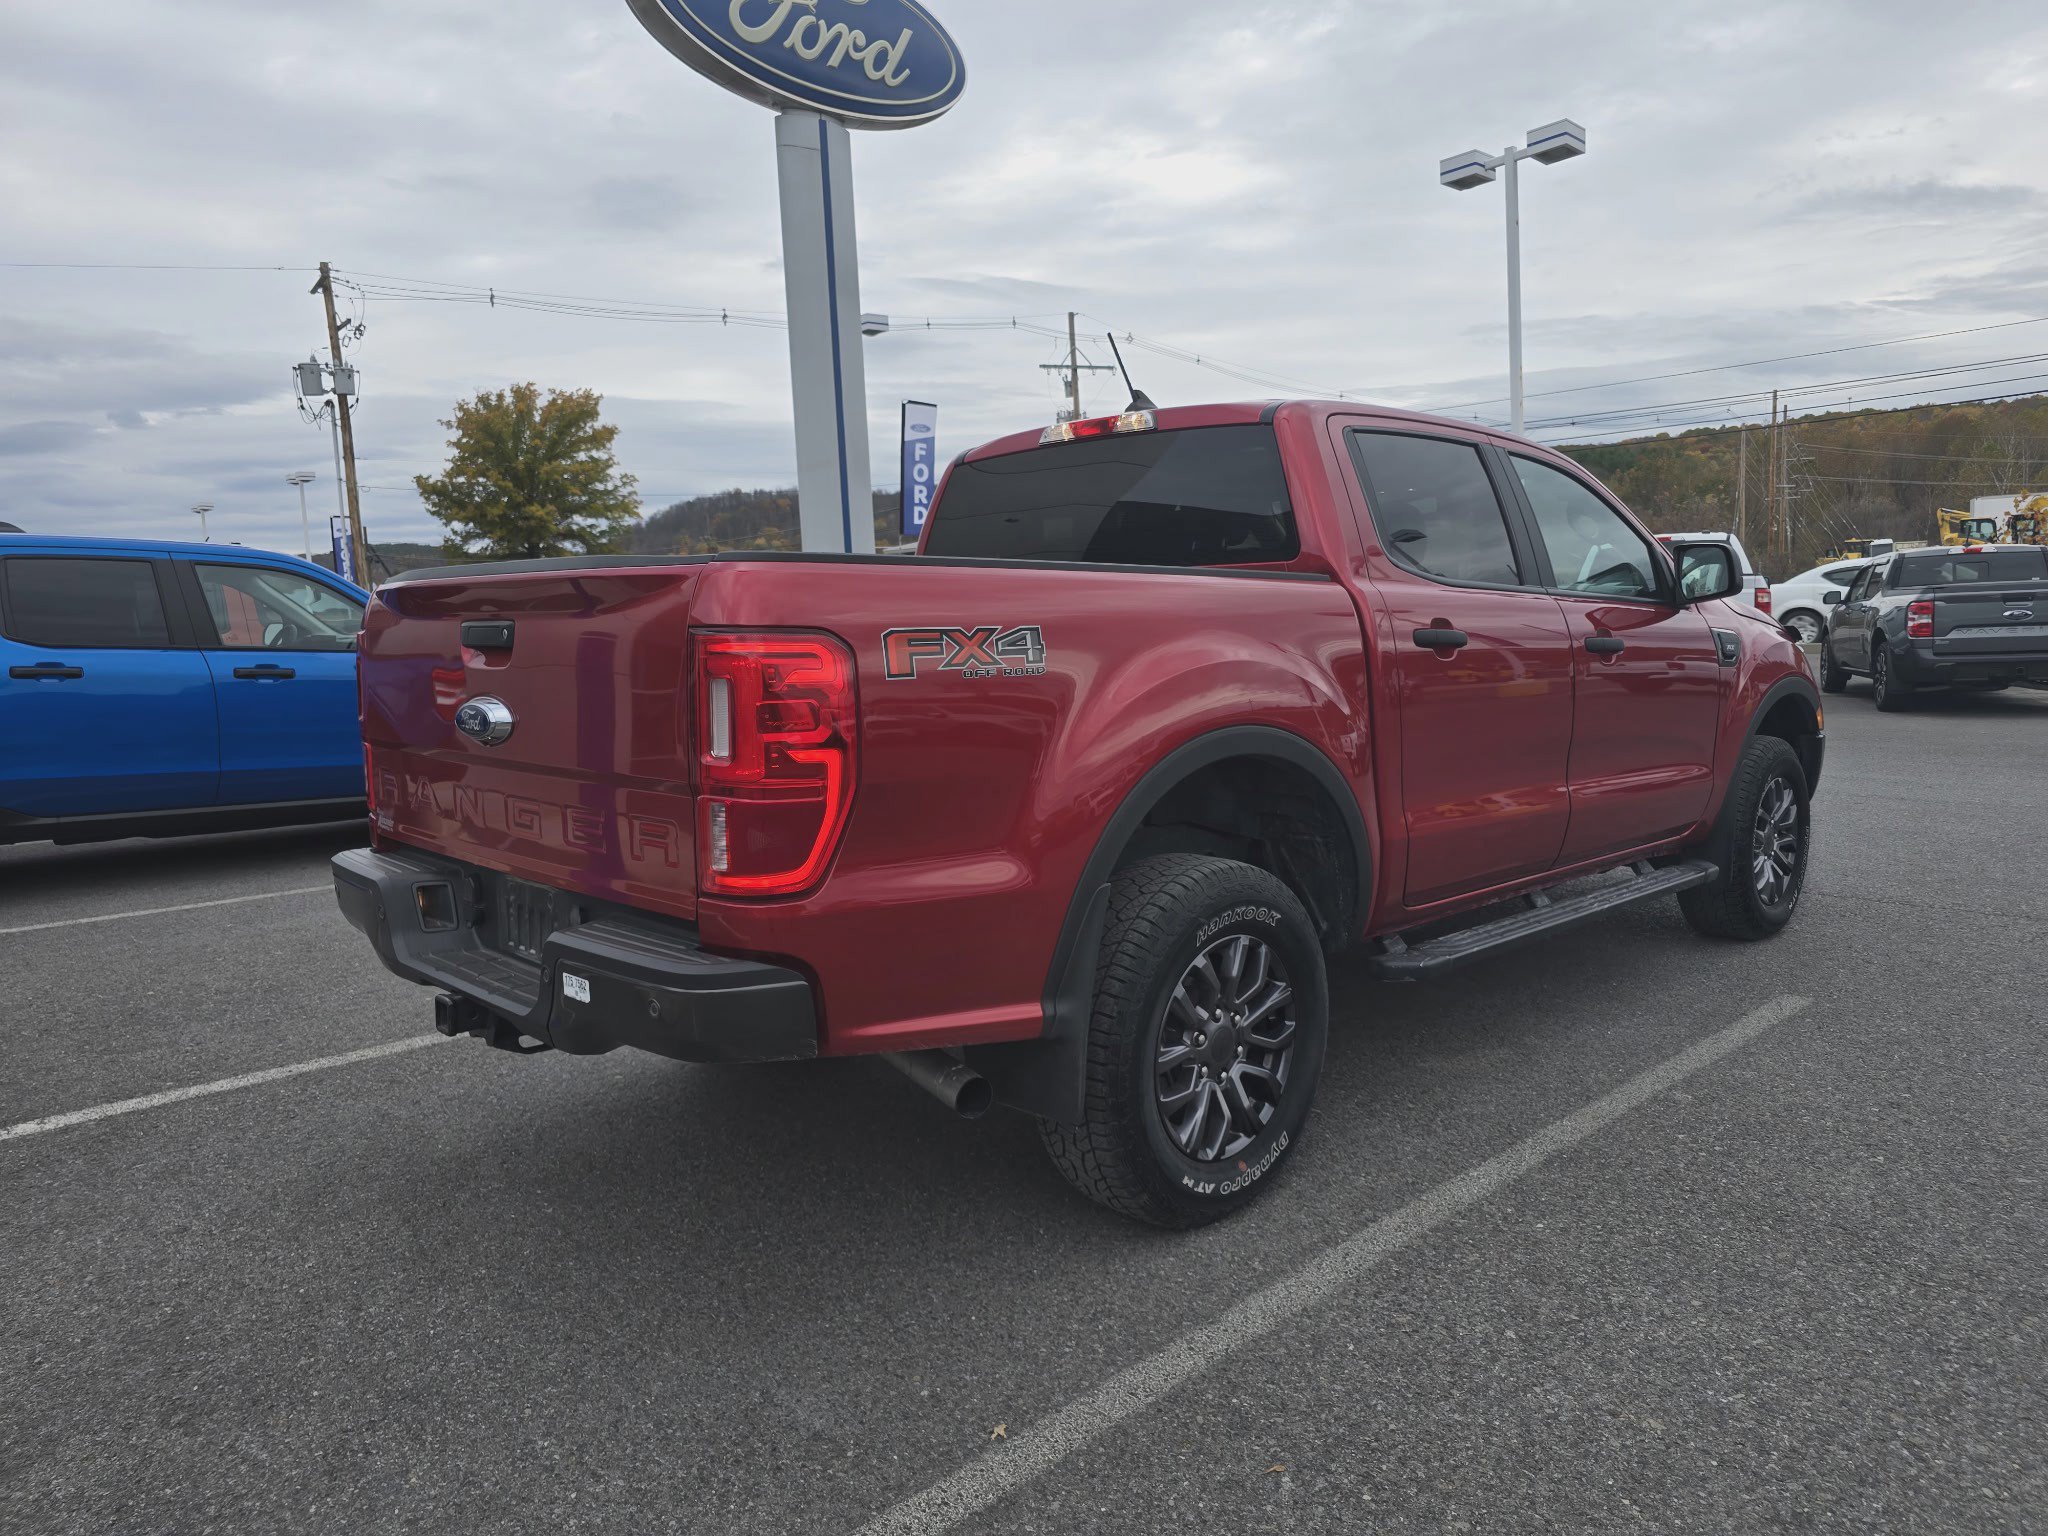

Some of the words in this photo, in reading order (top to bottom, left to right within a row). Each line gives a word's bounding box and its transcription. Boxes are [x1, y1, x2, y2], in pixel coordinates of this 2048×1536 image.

[913, 442, 929, 525] FORD
[881, 625, 1046, 681] FX4
[962, 667, 998, 679] OFF
[1003, 666, 1047, 677] ROAD
[377, 767, 681, 868] RANGER
